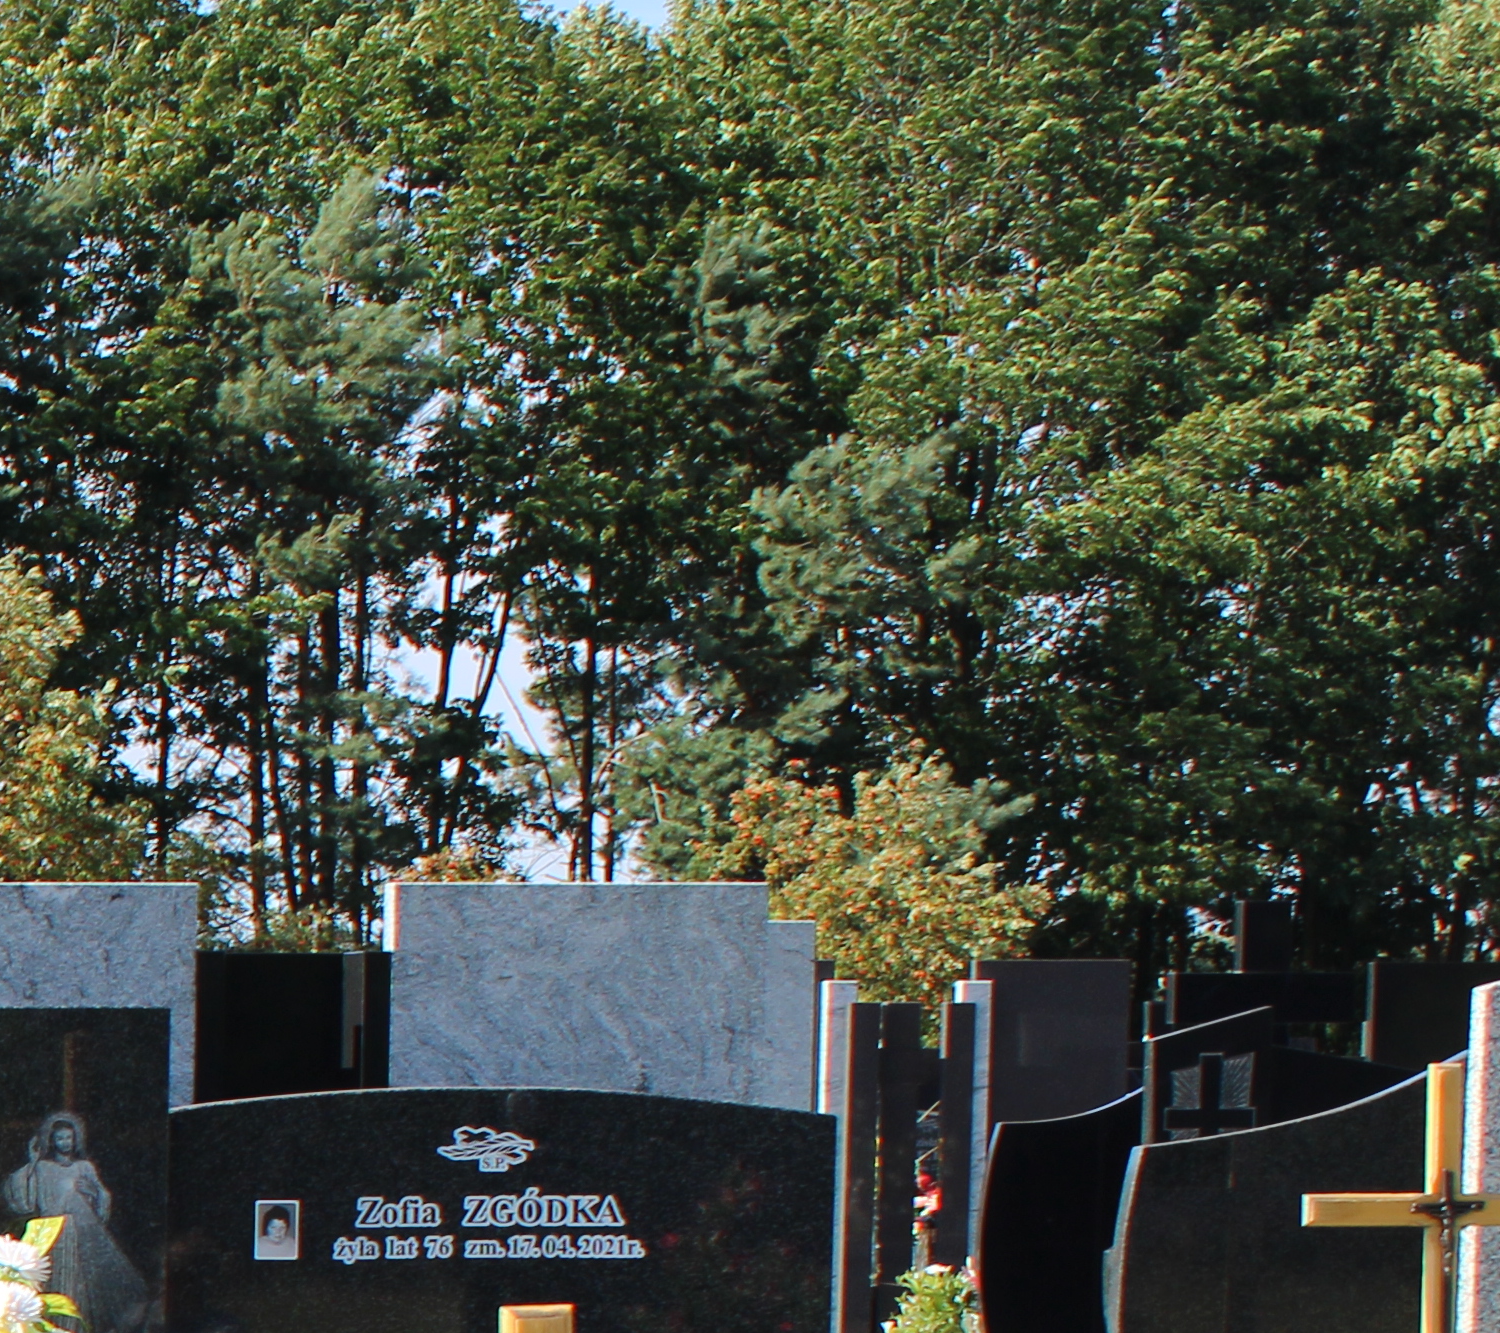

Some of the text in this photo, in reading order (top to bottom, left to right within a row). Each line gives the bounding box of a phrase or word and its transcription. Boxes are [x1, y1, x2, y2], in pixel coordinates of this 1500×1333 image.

[356, 1187, 624, 1228] Zofia ZGÓDKA
[386, 1236, 418, 1259] lat
[424, 1236, 454, 1259] 76
